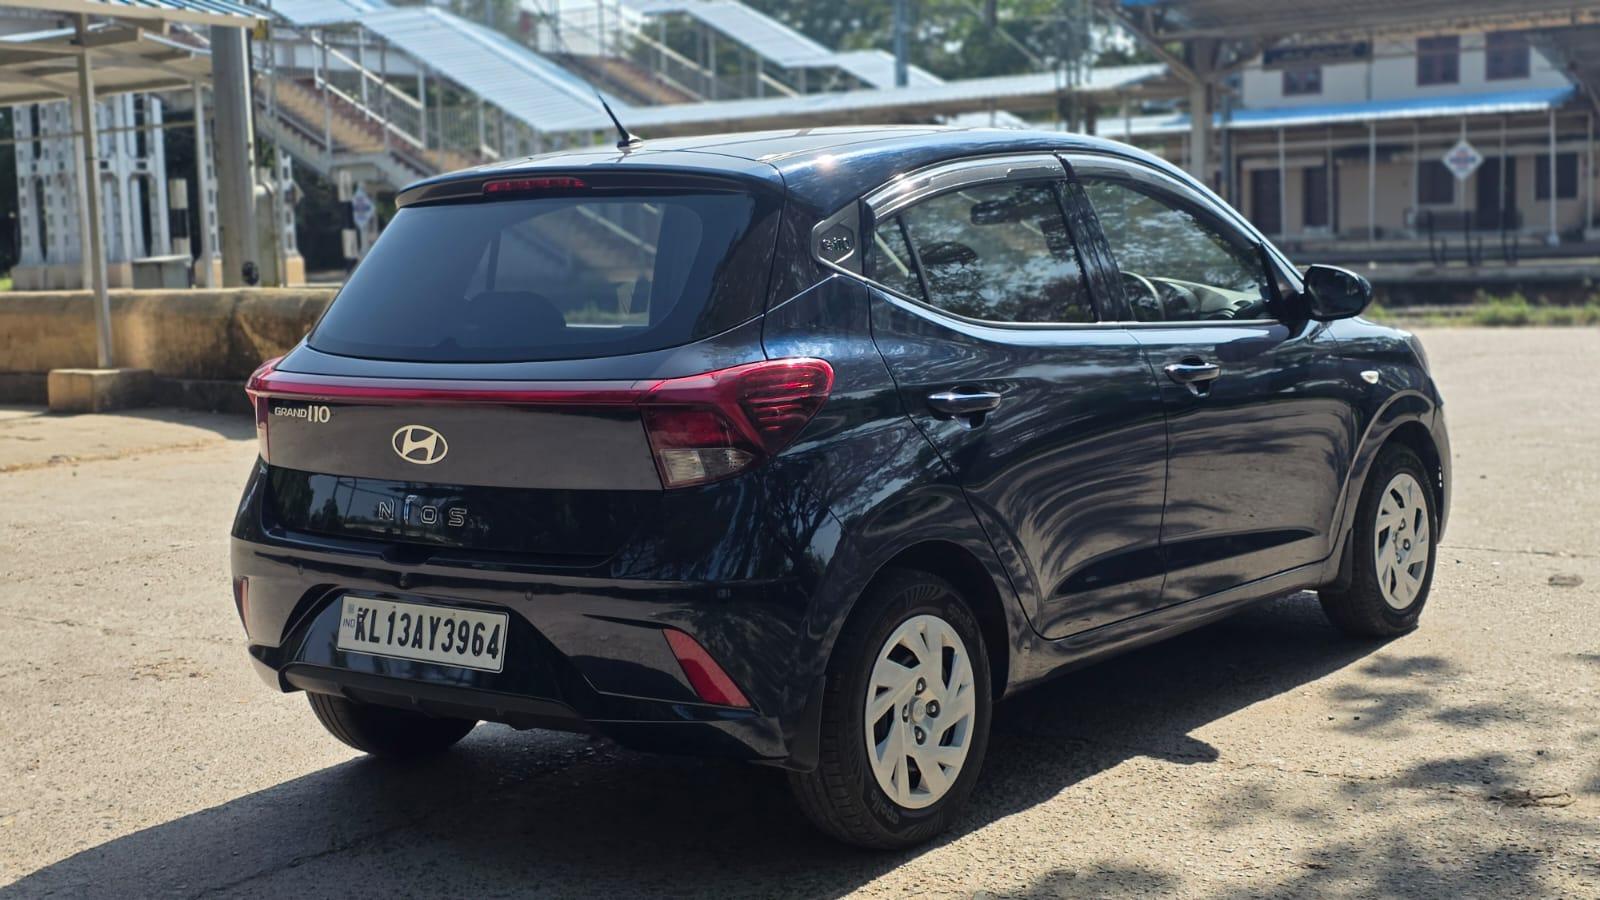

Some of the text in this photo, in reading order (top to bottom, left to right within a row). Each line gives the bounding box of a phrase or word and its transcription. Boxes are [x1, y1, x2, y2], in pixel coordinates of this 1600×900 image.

[274, 407, 307, 417] GRAND
[343, 618, 355, 628] IND
[354, 607, 501, 659] KL13AY3964
